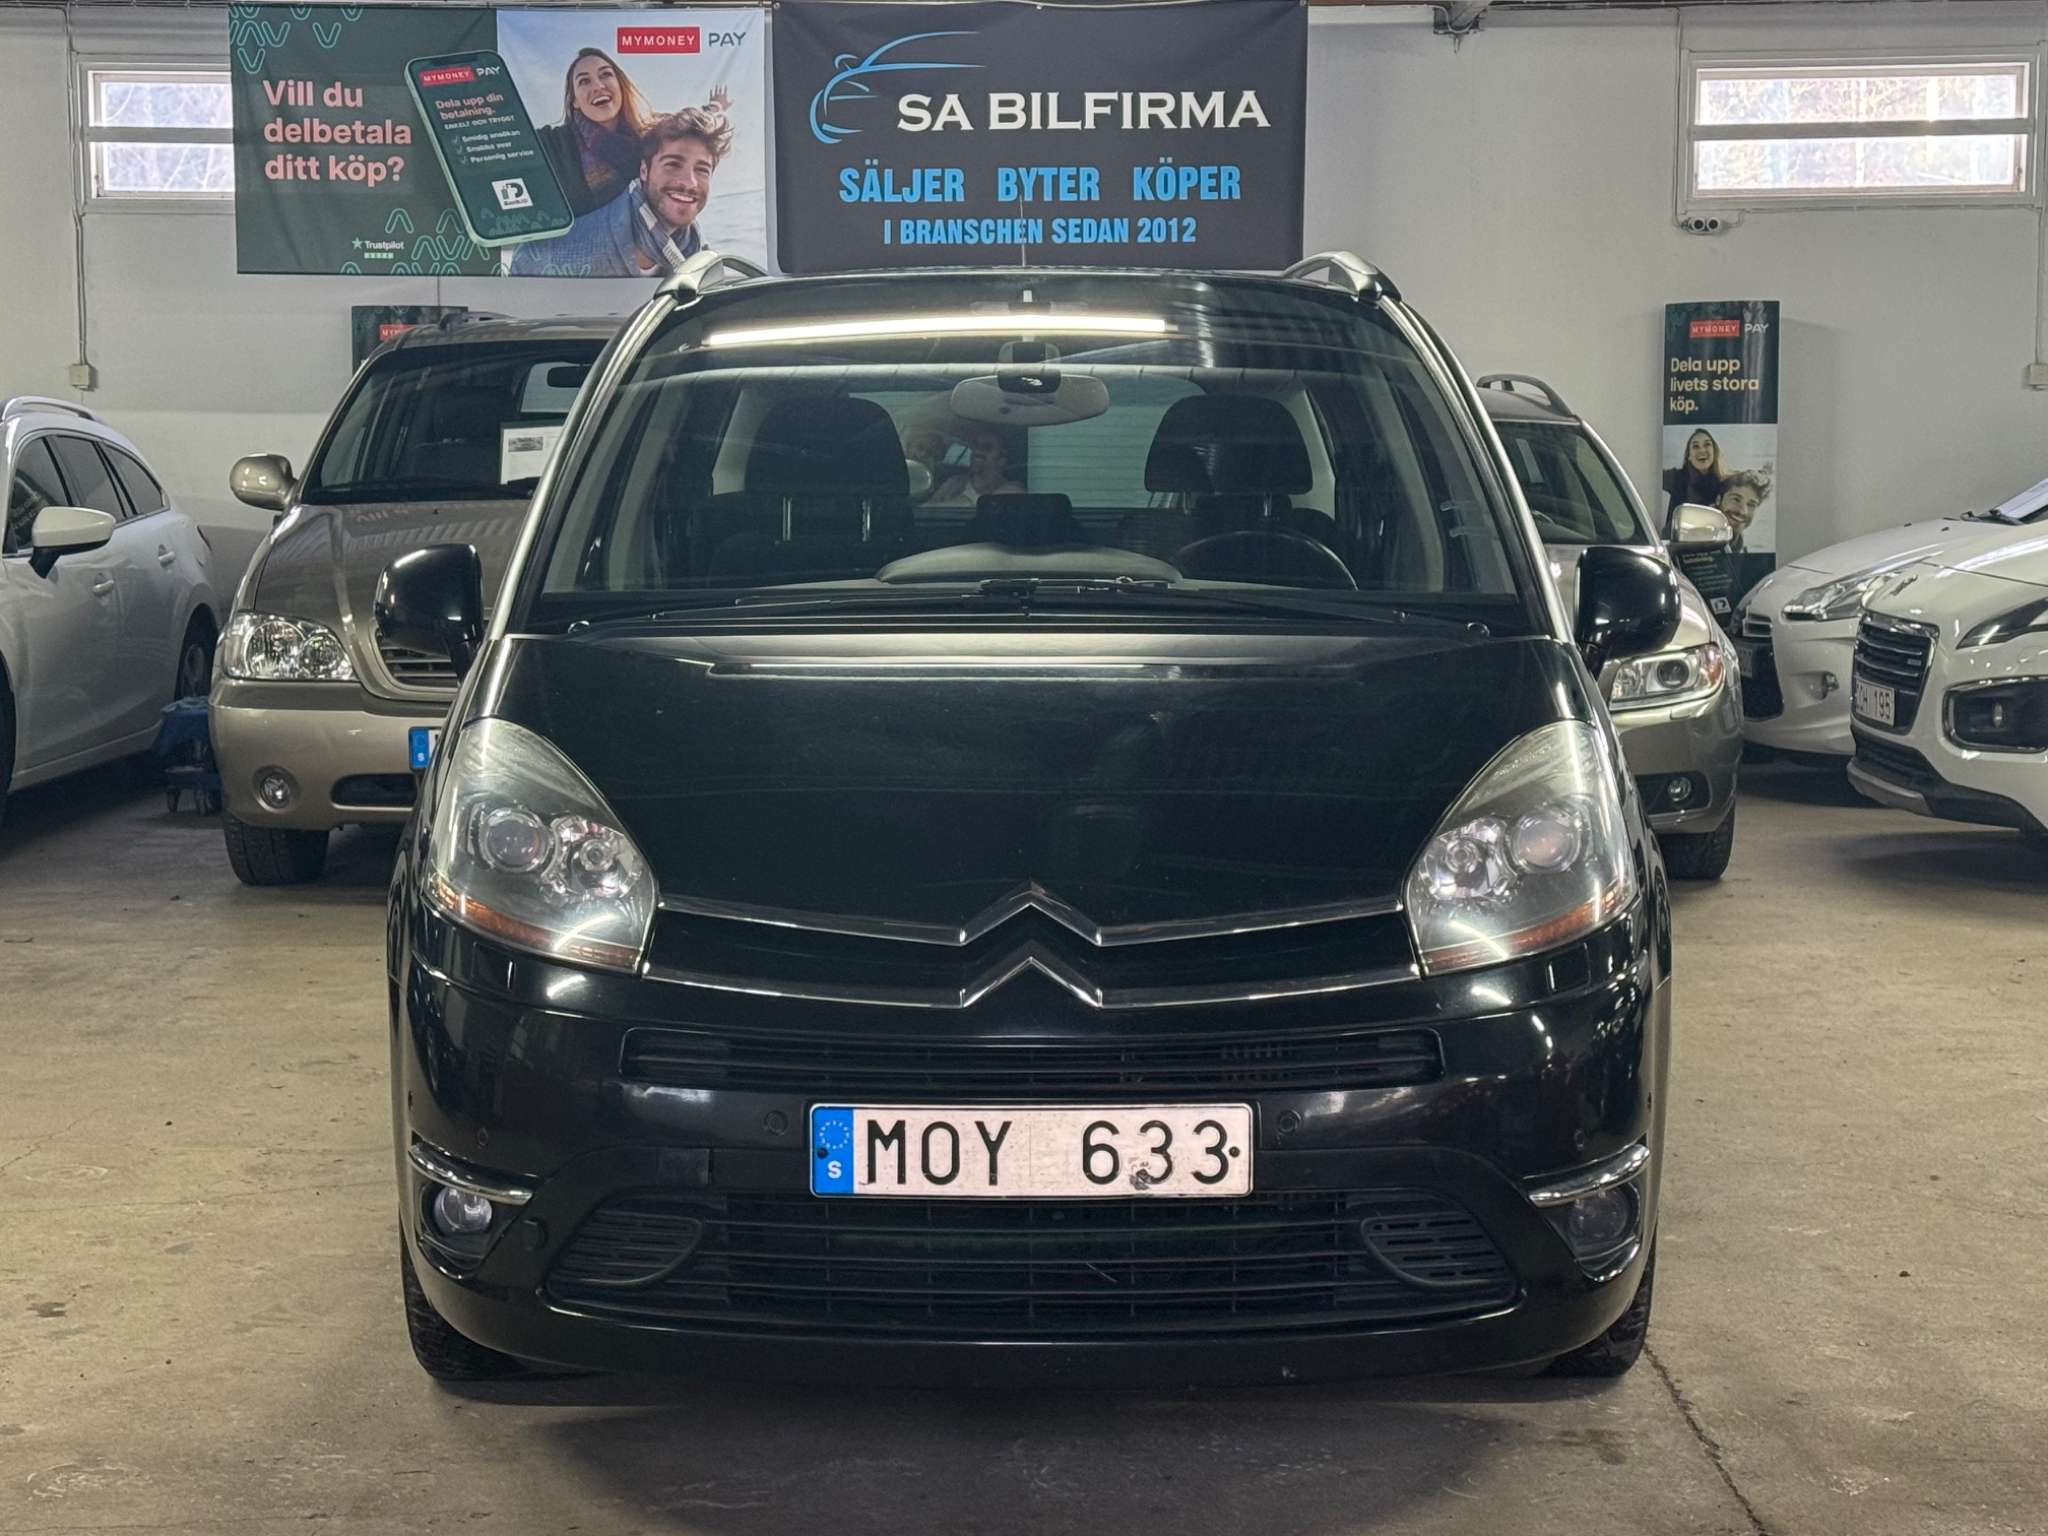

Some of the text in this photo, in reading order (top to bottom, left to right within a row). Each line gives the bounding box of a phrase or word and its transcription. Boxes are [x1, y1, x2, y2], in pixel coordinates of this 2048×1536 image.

[621, 31, 747, 47] MYMONEY PAY
[423, 66, 501, 83] MYMONEY PAY
[262, 79, 364, 108] Vill du
[434, 92, 505, 110] Dela upp din
[440, 106, 497, 120] betalning.
[897, 89, 1272, 132] SA BILFIRMA
[263, 117, 412, 145] delbetala
[444, 120, 471, 130] ENKELT
[471, 118, 488, 127] OCH
[265, 153, 405, 188] ditt köp?
[838, 156, 1241, 204] SÄLJER BYTER KÖPER
[883, 216, 1197, 245] I BRANSCHEN SEDAN 2012
[364, 240, 405, 251] Trustpilot
[1692, 323, 1770, 334] MYMONEY PAY
[1670, 356, 1741, 375] Dela upp
[1670, 376, 1760, 392] livets stora
[1670, 395, 1699, 415] köp.
[1874, 690, 1892, 720] 195
[827, 1119, 1229, 1186] S MOY 633
